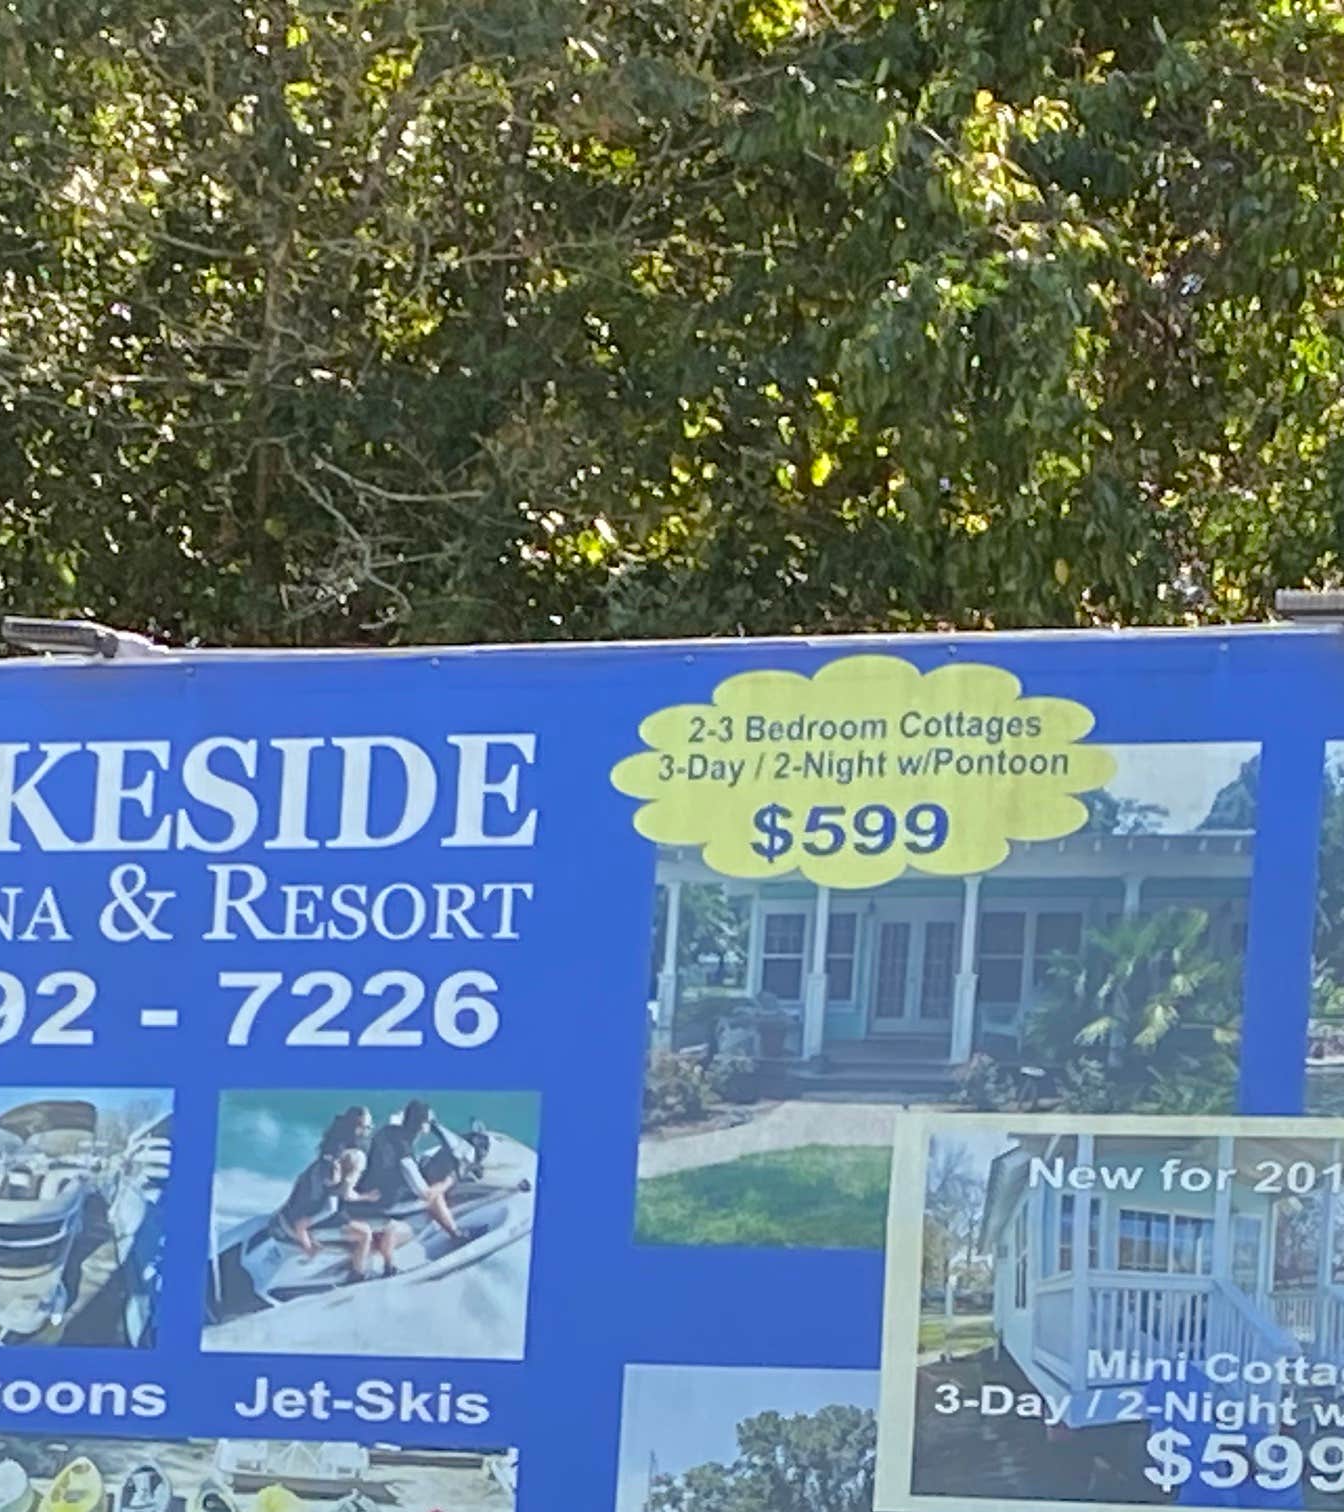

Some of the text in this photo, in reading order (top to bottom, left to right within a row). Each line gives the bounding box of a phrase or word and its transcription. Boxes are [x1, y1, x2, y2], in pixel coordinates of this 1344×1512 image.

[688, 710, 1043, 746] 2-3 Bedroom Cottages
[658, 748, 1069, 788] 3-Day / 2-Night w/Pontoon
[751, 802, 950, 863] $599
[99, 862, 175, 942] &
[203, 862, 534, 942] RESORT
[140, 1007, 179, 1029] -
[219, 970, 501, 1048] 7226
[1028, 1156, 1145, 1192] New
[1159, 1157, 1235, 1192] for
[1087, 1348, 1192, 1384] Mini
[235, 1376, 491, 1426] Jet-Skis
[934, 1383, 1071, 1427] 3-Day
[1085, 1389, 1104, 1422] /
[1116, 1389, 1299, 1433] 2-Night
